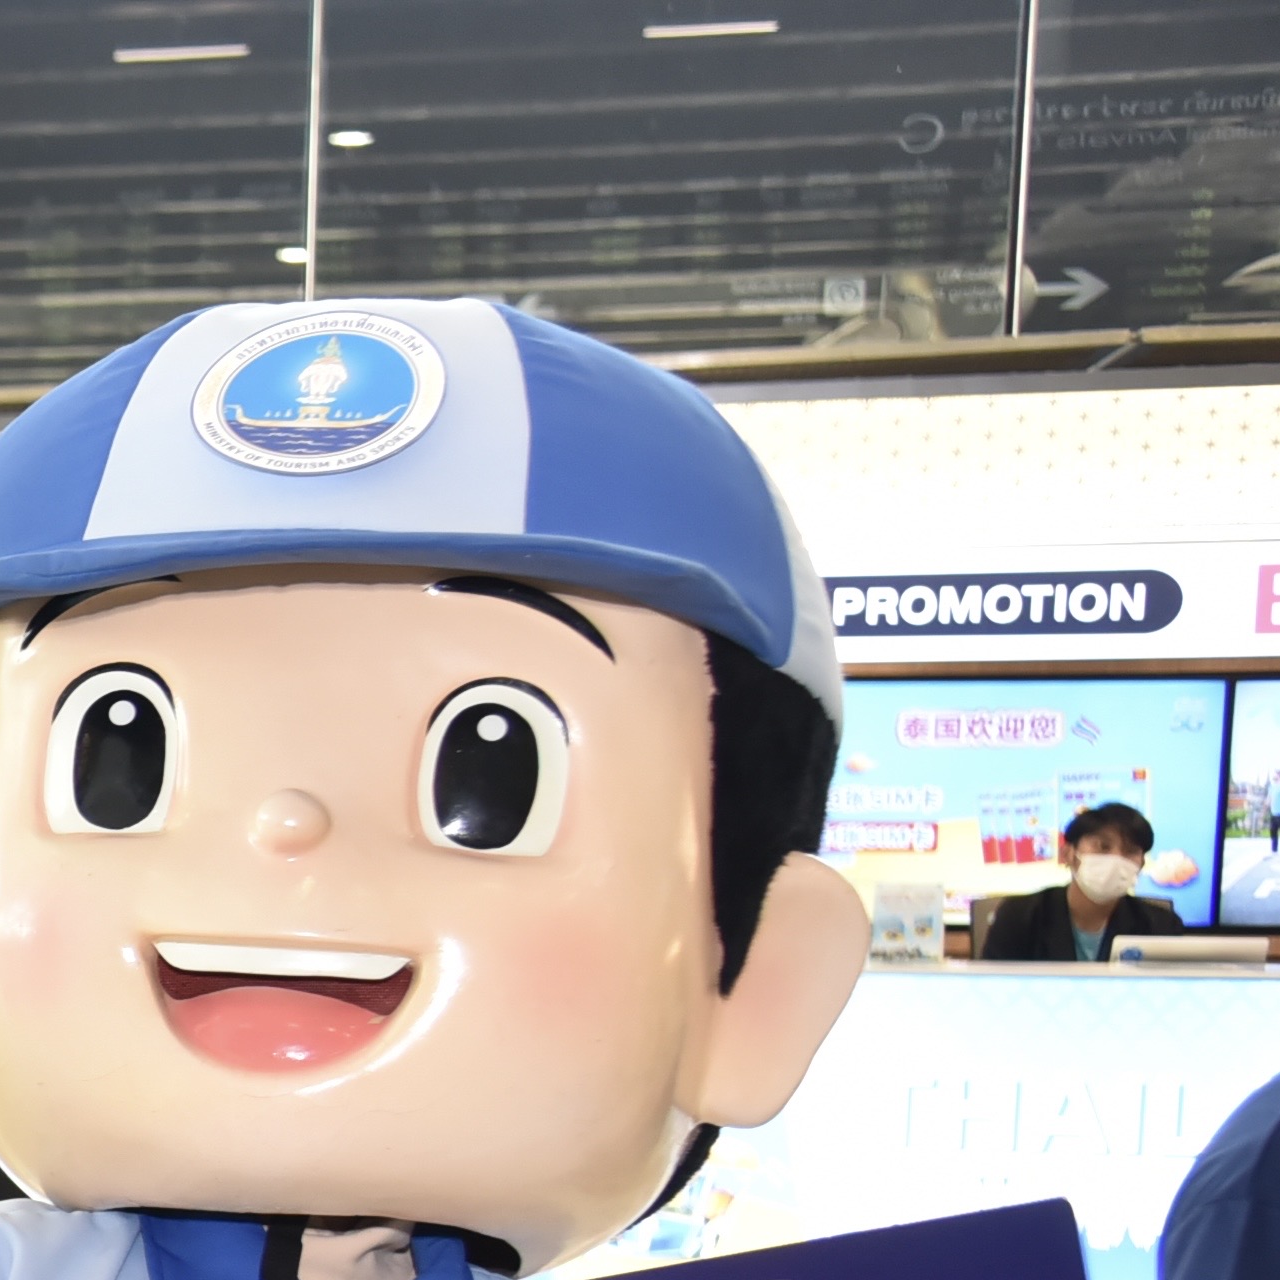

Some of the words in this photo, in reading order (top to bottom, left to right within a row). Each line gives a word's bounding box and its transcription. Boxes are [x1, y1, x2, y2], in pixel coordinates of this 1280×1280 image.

[203, 421, 246, 455] MINISTRY
[245, 452, 262, 462] OF
[265, 458, 331, 470] TOURISM
[336, 453, 367, 467] AND
[370, 424, 417, 457] SPORTS
[831, 582, 1147, 627] PROMOTION
